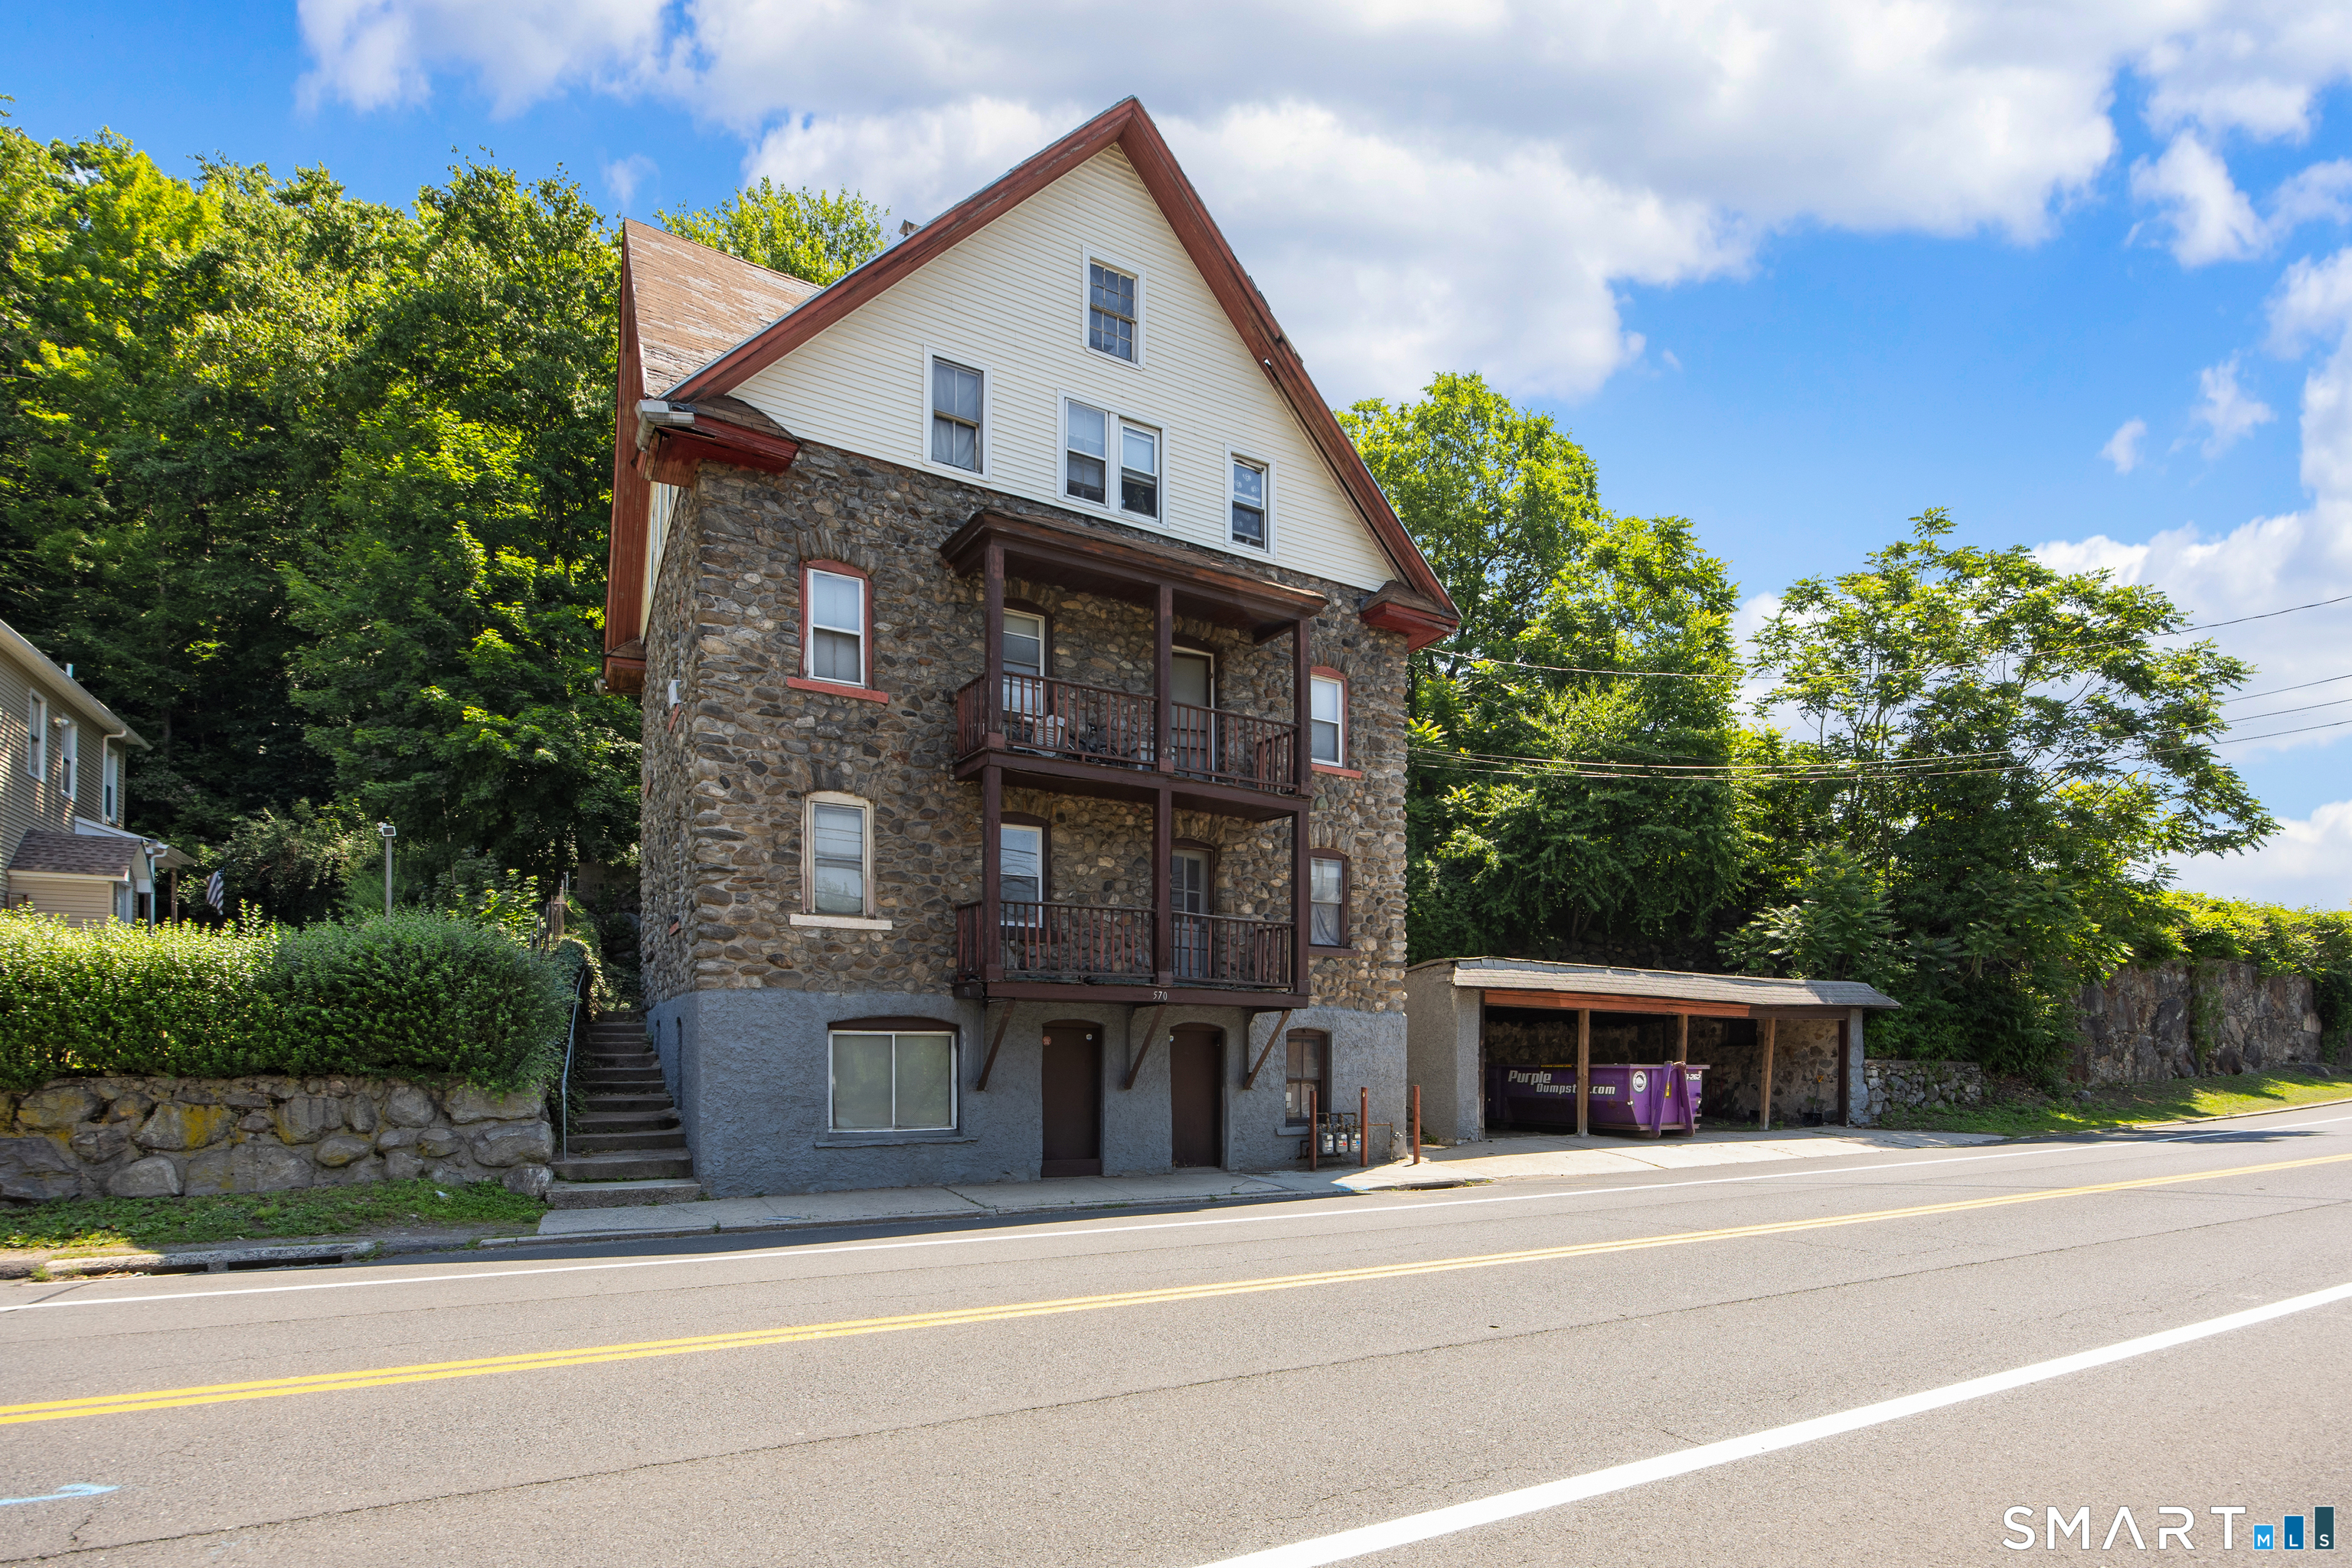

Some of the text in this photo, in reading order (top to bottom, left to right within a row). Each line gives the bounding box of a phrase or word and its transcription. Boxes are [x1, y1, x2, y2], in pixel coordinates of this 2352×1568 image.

[1153, 991, 1168, 1001] 570
[1508, 1070, 1552, 1086] Purple
[1536, 1083, 1616, 1095] Dumpst.com
